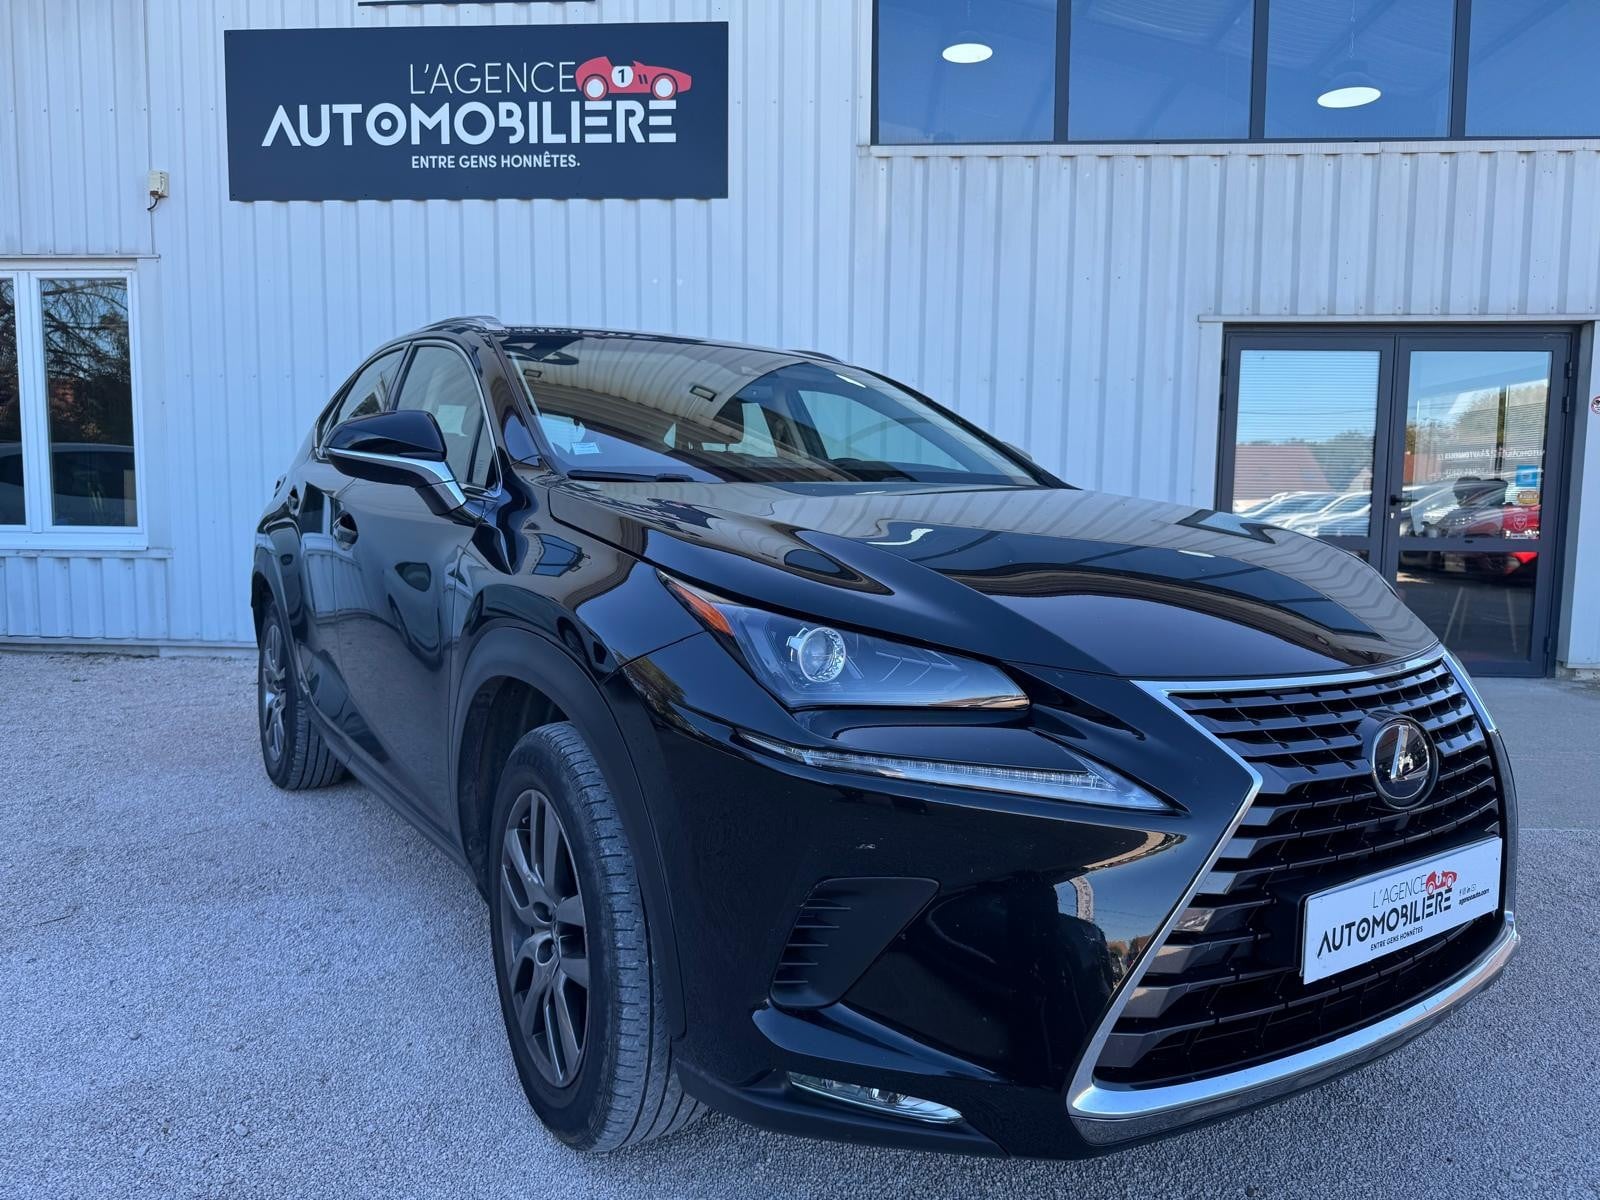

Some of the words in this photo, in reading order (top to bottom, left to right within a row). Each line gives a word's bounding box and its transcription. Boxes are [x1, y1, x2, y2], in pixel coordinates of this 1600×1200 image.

[409, 61, 577, 95] L'AGENCE
[618, 68, 625, 83] 1
[411, 155, 456, 169] ENTRE
[459, 154, 497, 169] GENS
[500, 151, 581, 168] HONNÊTES.
[1372, 874, 1427, 909] L'AGENCE
[1370, 939, 1387, 951] ENTRE
[1386, 934, 1400, 945] GENS
